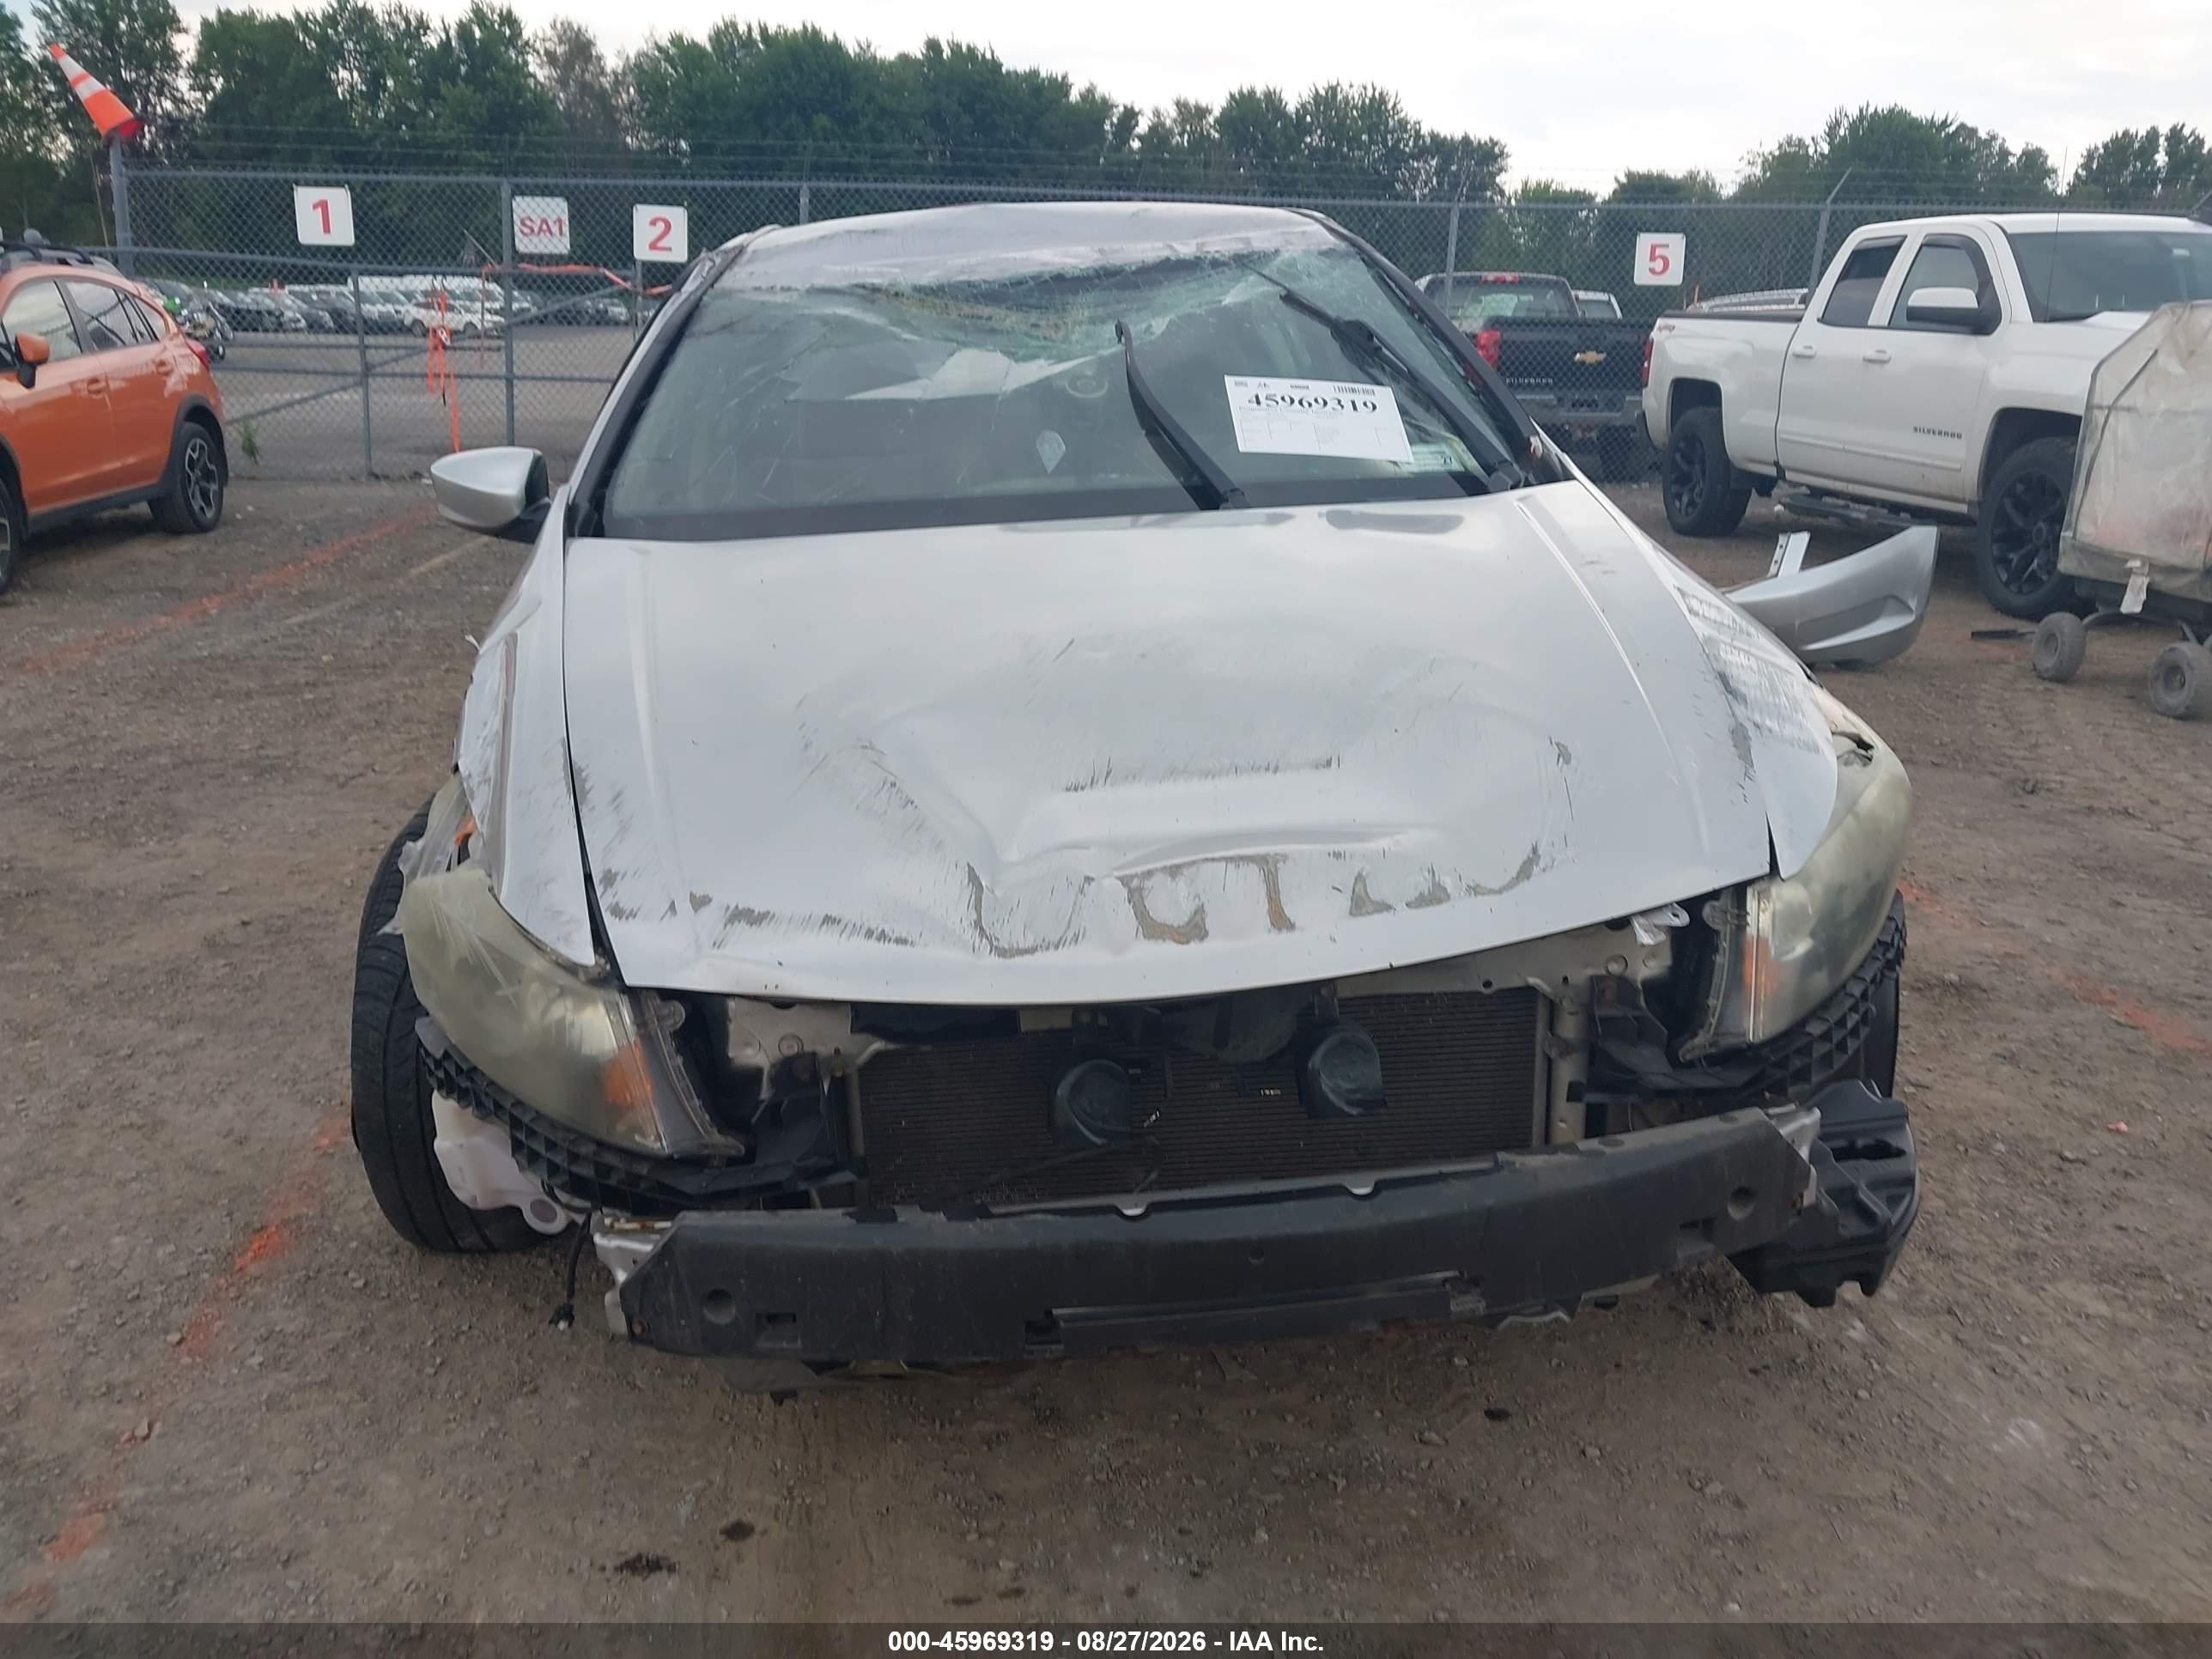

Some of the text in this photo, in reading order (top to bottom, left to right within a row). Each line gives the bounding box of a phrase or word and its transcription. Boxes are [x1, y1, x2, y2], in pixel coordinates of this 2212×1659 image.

[312, 199, 331, 234] 1
[519, 216, 563, 237] SA1
[648, 216, 673, 252] 2
[1648, 244, 1670, 276] 5
[1248, 392, 1377, 413] 45969319
